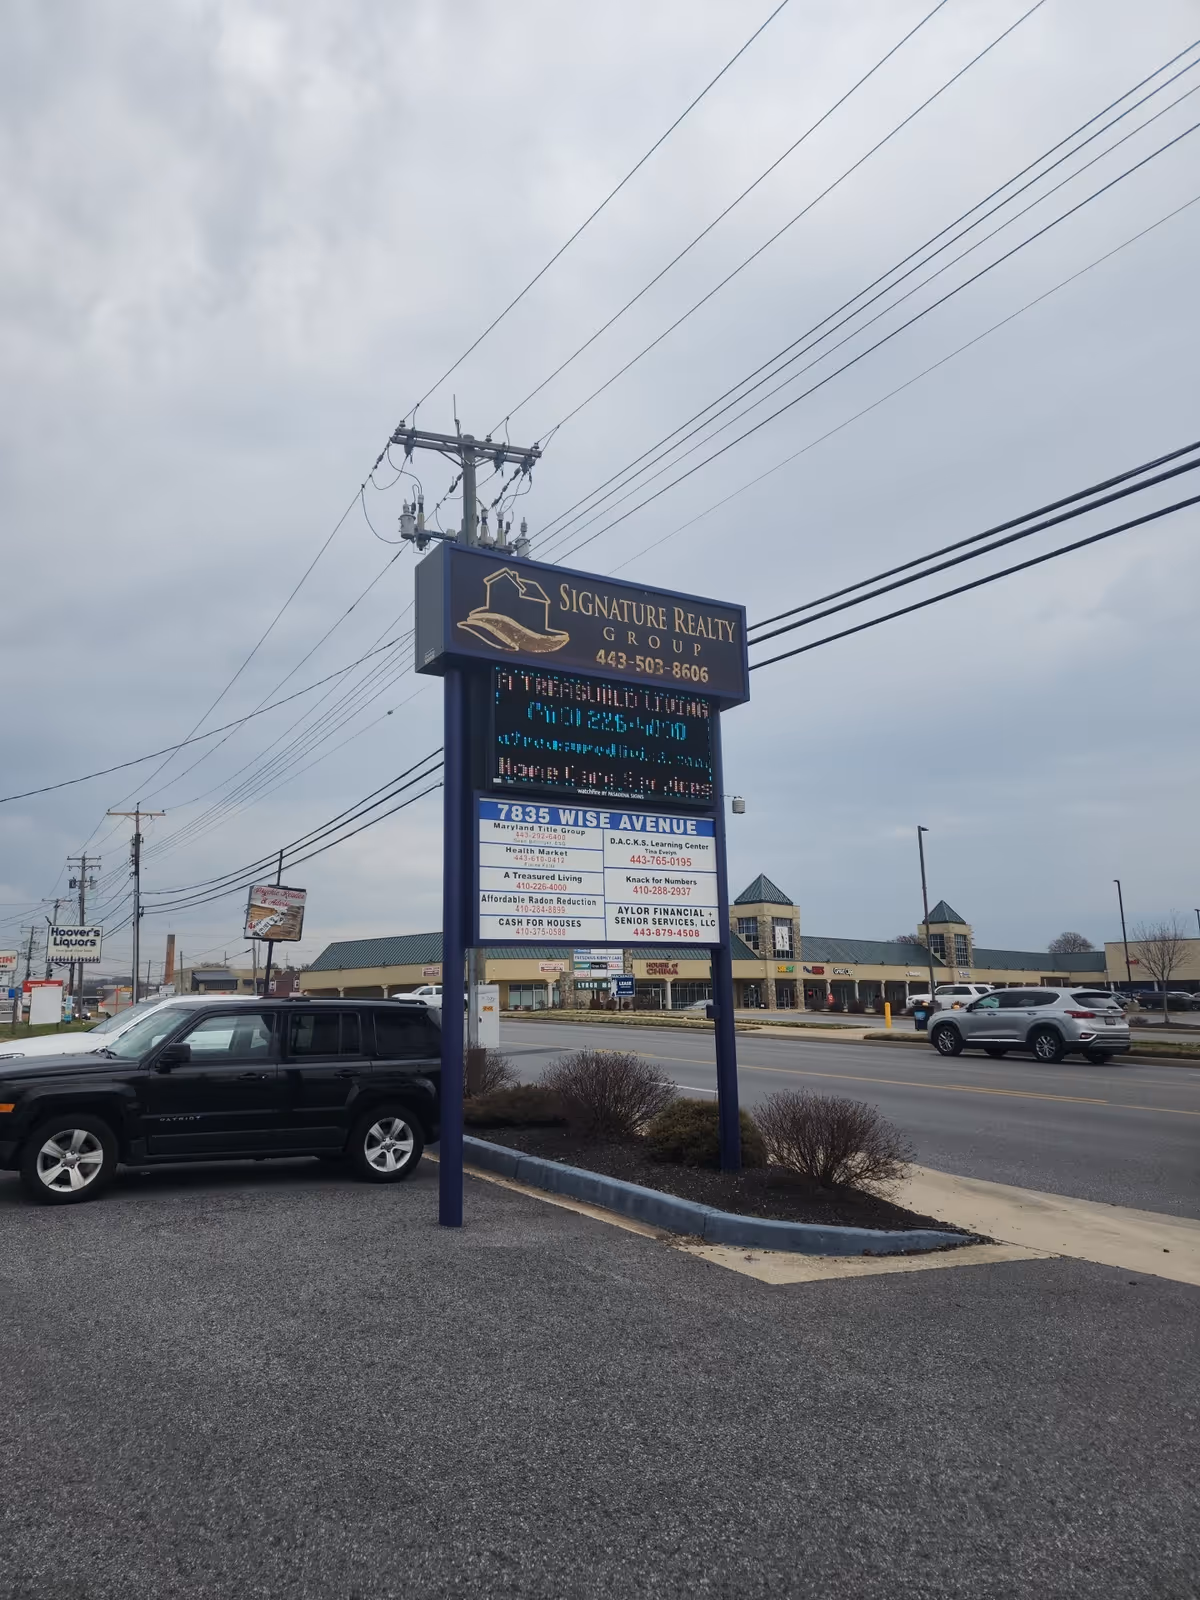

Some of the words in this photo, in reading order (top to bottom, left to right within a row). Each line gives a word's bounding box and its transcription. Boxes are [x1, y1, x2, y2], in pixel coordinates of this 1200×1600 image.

[560, 583, 668, 630] SIGNATURE
[673, 606, 736, 643] REALTY
[603, 626, 702, 656] GROUP
[596, 649, 709, 683] 443-503-8606
[498, 804, 550, 823] 7835
[558, 809, 611, 828] WISE
[619, 815, 697, 835] AVENUE
[493, 822, 535, 832] Maryland
[538, 825, 558, 833] Title
[561, 827, 586, 836] Group
[610, 838, 649, 847] D.A.C.K.S.
[651, 840, 683, 850] Learning
[685, 842, 709, 850] Center
[505, 846, 535, 855] Health
[538, 848, 568, 857] Market
[629, 855, 692, 867] 443-765-0195
[503, 871, 510, 879] A
[513, 871, 556, 881] Treasured
[558, 874, 583, 884] Living
[626, 876, 650, 884] Knack
[652, 876, 663, 884] for
[664, 877, 698, 886] Numbers
[516, 882, 567, 892] 410-226-4000
[633, 885, 691, 896] 410-288-2937
[481, 894, 525, 904] Affordable
[528, 896, 553, 905] Radon
[556, 896, 597, 906] Reduction
[617, 906, 650, 916] AYLOR
[653, 907, 705, 917] FINANCIAL
[498, 918, 523, 927] CASH
[526, 918, 544, 927] FOR
[547, 919, 582, 928] HOUSES
[614, 917, 649, 925] SENIOR
[652, 918, 698, 927] SERVICES,
[700, 919, 716, 927] LLC
[51, 927, 100, 937] Hoover's
[53, 936, 96, 948] Liquors
[647, 968, 678, 976] CHINA
